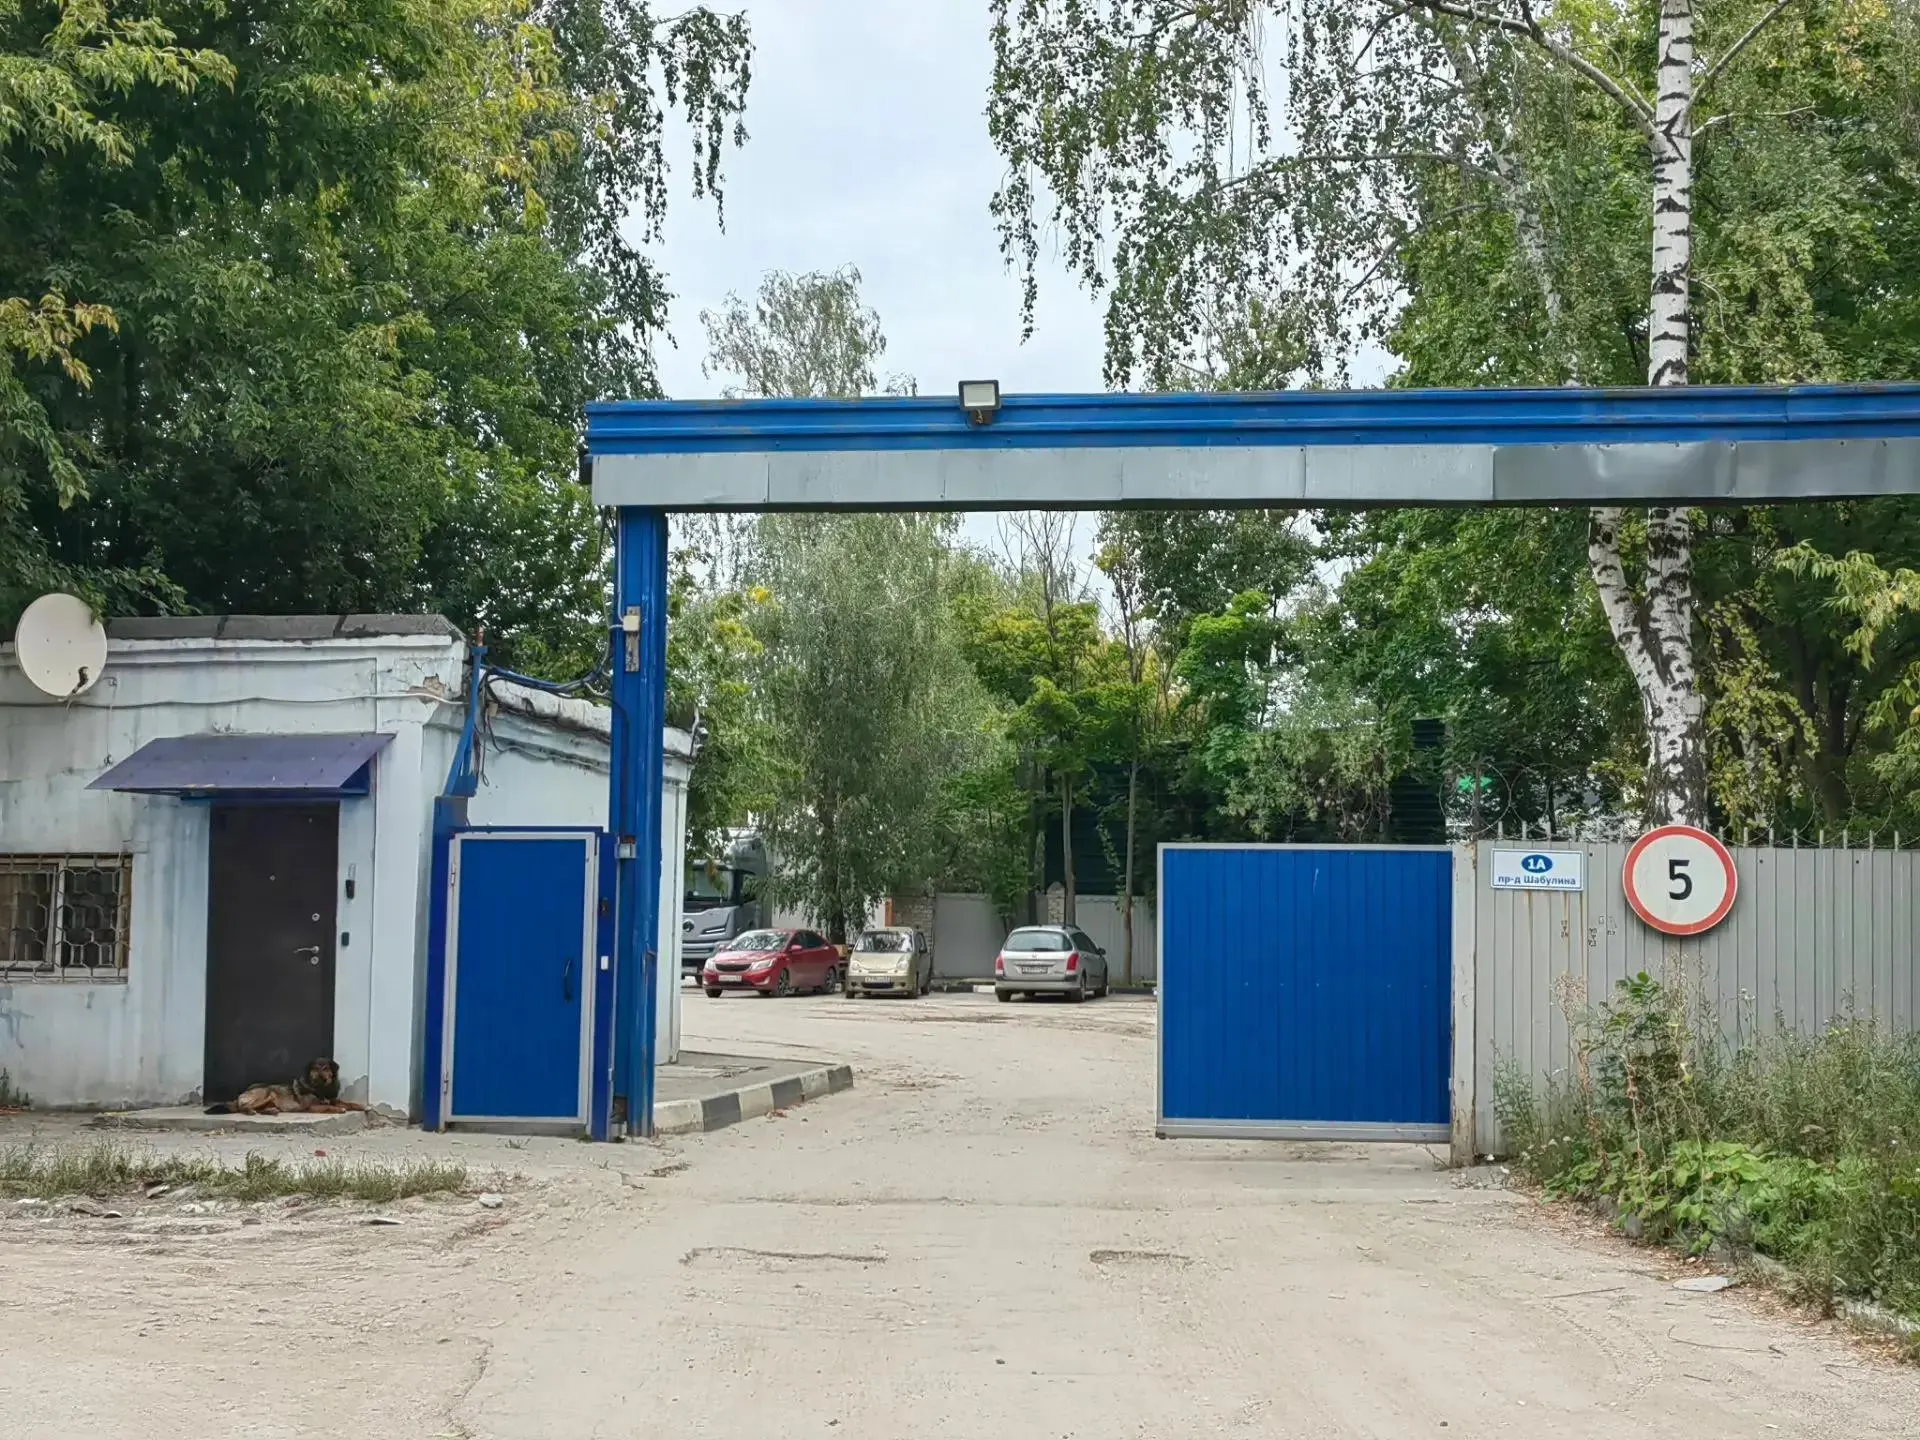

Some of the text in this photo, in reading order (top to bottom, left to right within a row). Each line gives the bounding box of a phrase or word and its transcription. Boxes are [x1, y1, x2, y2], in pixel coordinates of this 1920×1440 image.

[1527, 858, 1546, 870] 1А
[1498, 875, 1576, 886] пр-д Шабулина
[1669, 859, 1692, 900] 5
